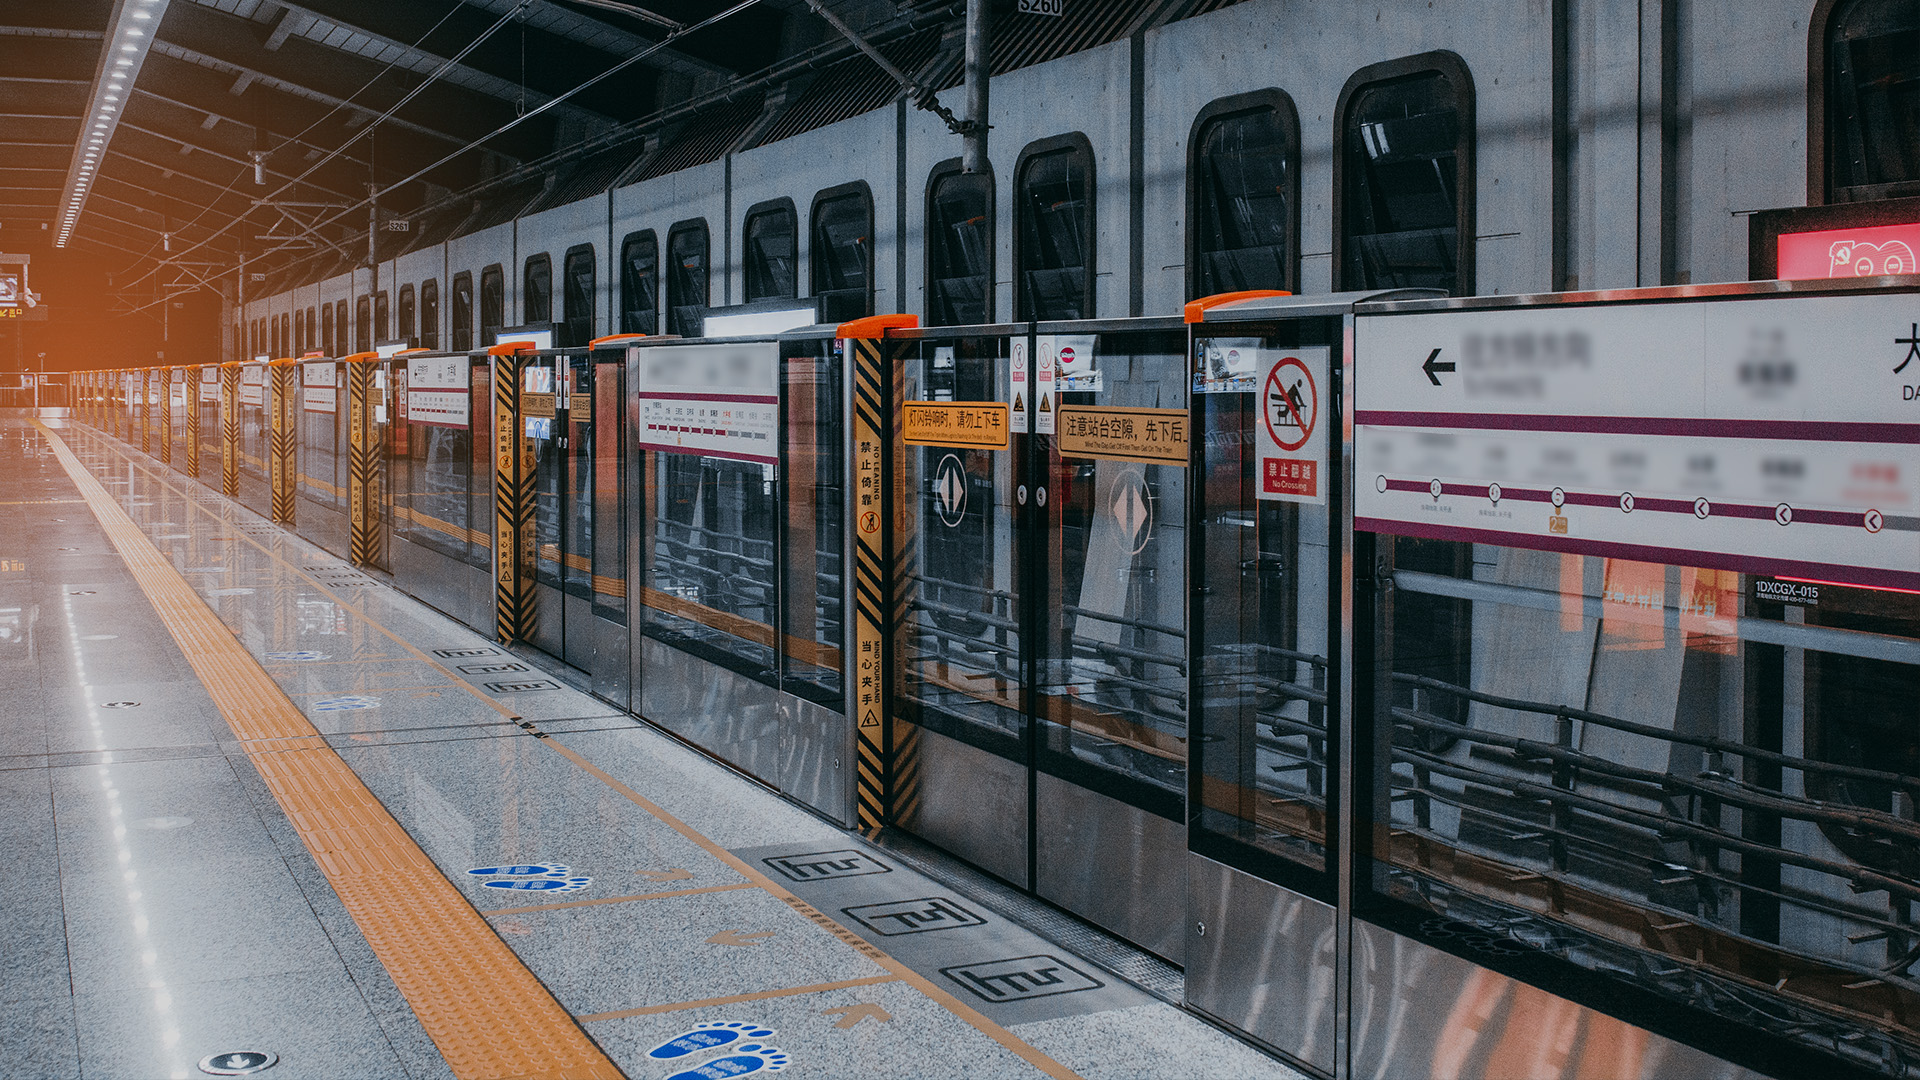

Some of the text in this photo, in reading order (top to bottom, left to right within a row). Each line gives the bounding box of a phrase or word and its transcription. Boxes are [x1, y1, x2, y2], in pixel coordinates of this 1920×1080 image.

[390, 222, 408, 231] S261
[1066, 416, 1188, 443] 注意站台空隙，先下后
[874, 446, 880, 458] NO
[861, 441, 872, 506] 禁止倚靠
[1269, 462, 1311, 479] 禁止翻越
[1272, 480, 1307, 491] No Crossing
[1755, 581, 1819, 598] 1DXCGX-015
[861, 640, 872, 705] 当心夹手
